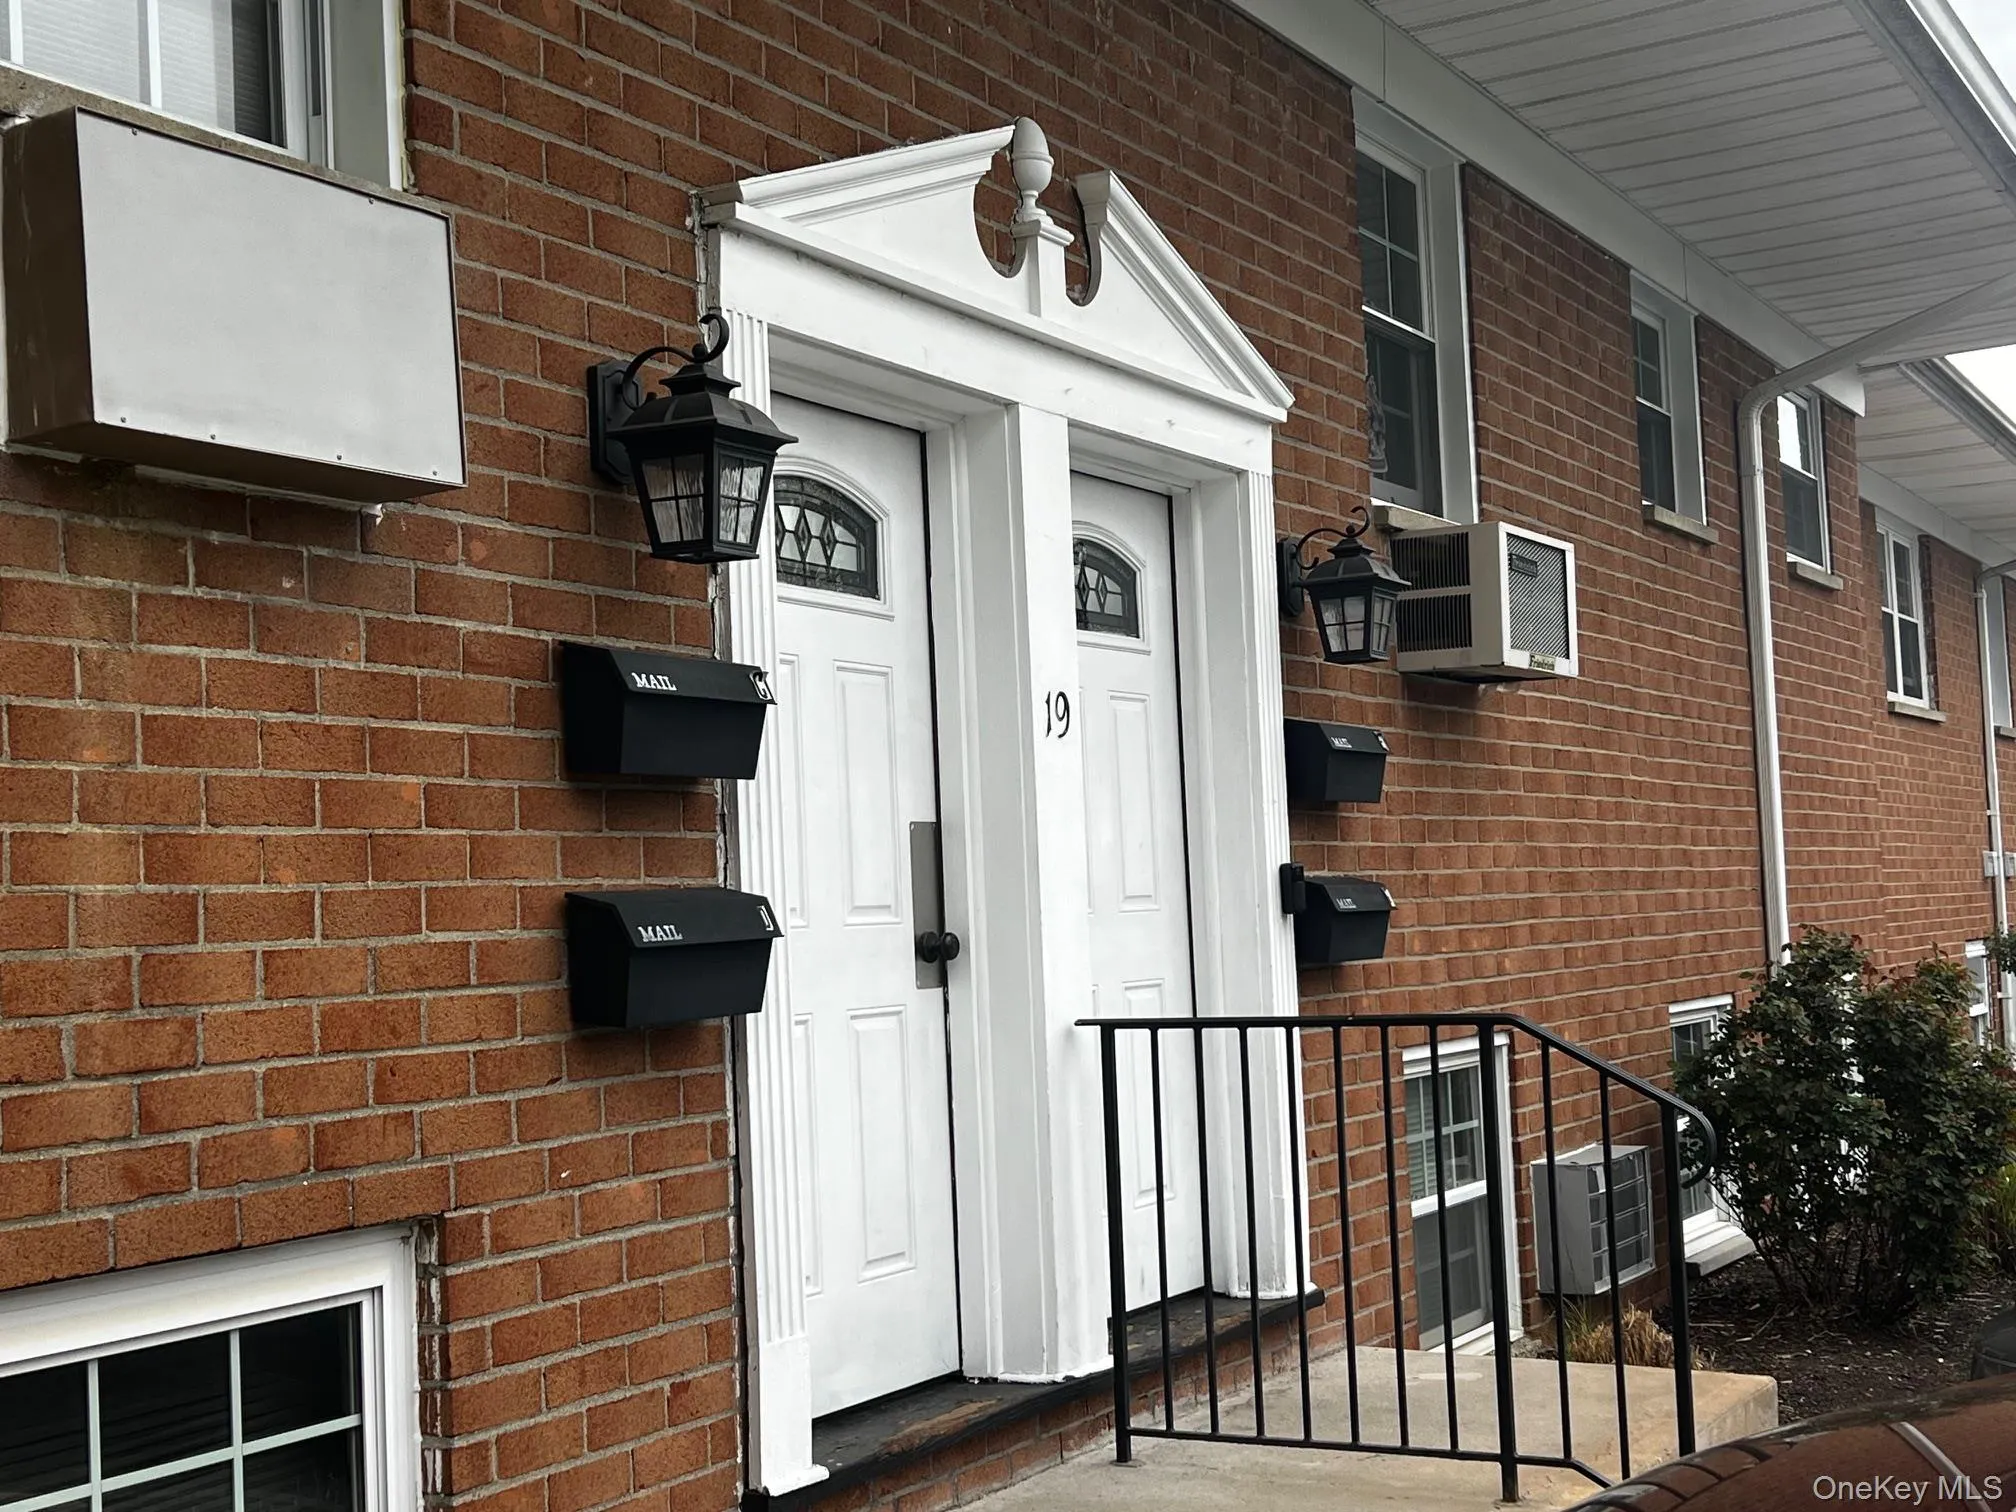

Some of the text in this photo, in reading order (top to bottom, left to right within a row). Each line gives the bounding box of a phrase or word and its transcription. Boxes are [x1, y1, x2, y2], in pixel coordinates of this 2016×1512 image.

[631, 672, 677, 691] MAIL
[1045, 691, 1070, 738] 19
[638, 925, 684, 942] MAIL
